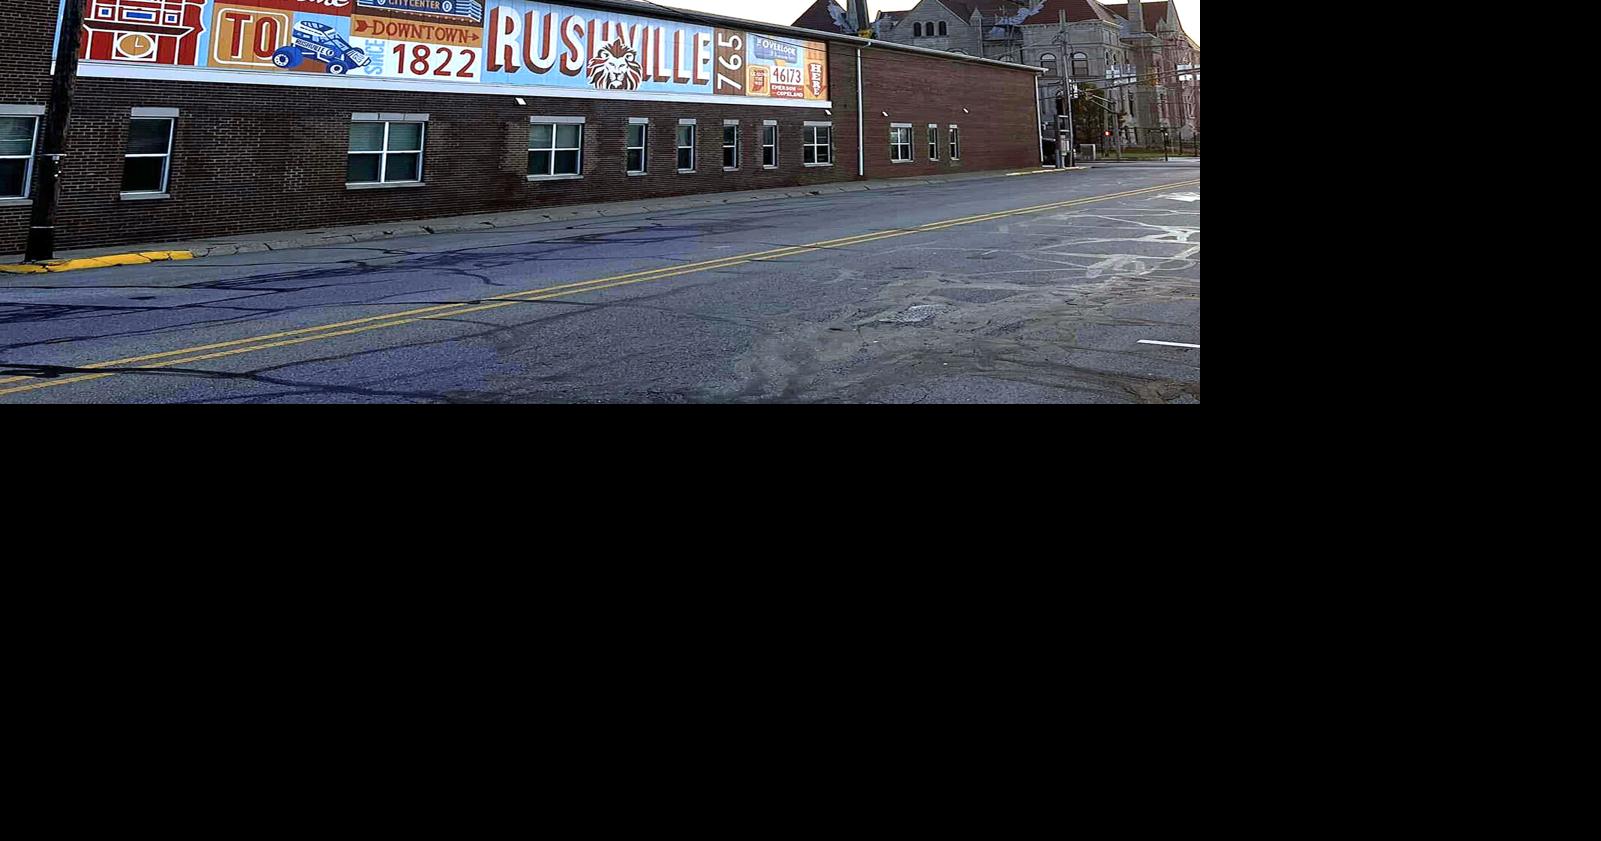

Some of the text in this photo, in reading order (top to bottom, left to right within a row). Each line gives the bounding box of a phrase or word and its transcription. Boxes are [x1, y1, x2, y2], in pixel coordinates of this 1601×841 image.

[225, 12, 280, 60] TO
[371, 20, 468, 43] DOWNTOWN
[487, 6, 710, 85] RUSHVILLE
[364, 39, 385, 75] SINCE
[393, 44, 476, 78] 1822
[717, 33, 742, 90] 765
[773, 67, 802, 83] 46173
[810, 63, 821, 97] HERE
